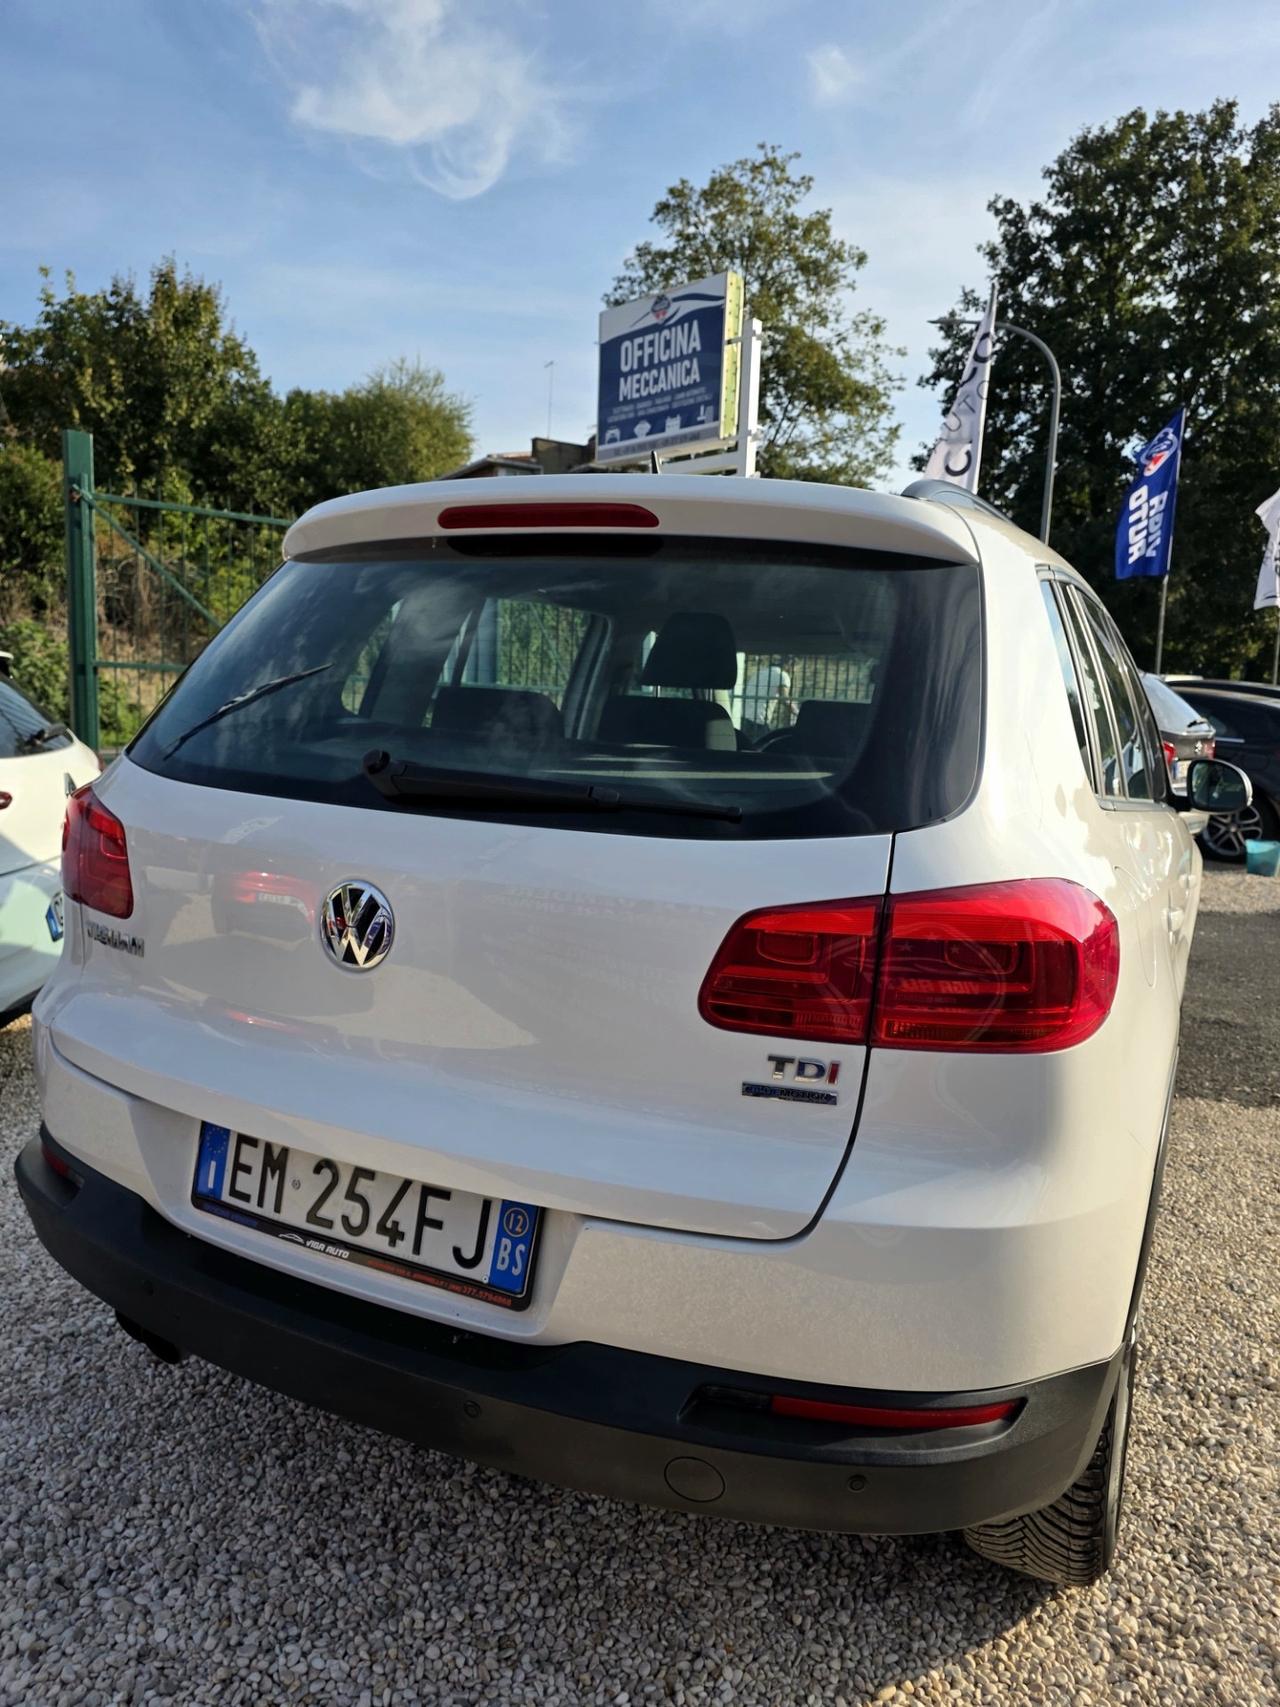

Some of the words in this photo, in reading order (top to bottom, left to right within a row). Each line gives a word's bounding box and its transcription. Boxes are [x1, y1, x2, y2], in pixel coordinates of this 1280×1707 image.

[620, 319, 701, 373] OFFICINA
[618, 357, 700, 402] MECCANICA
[767, 1055, 840, 1085] TDI
[207, 1160, 217, 1190] I
[229, 1132, 290, 1214] EM
[306, 1157, 493, 1270] 254FJ
[509, 1213, 524, 1234] 12
[306, 1239, 325, 1251] VIGA
[325, 1246, 350, 1259] AUTO
[496, 1237, 526, 1276] BS
